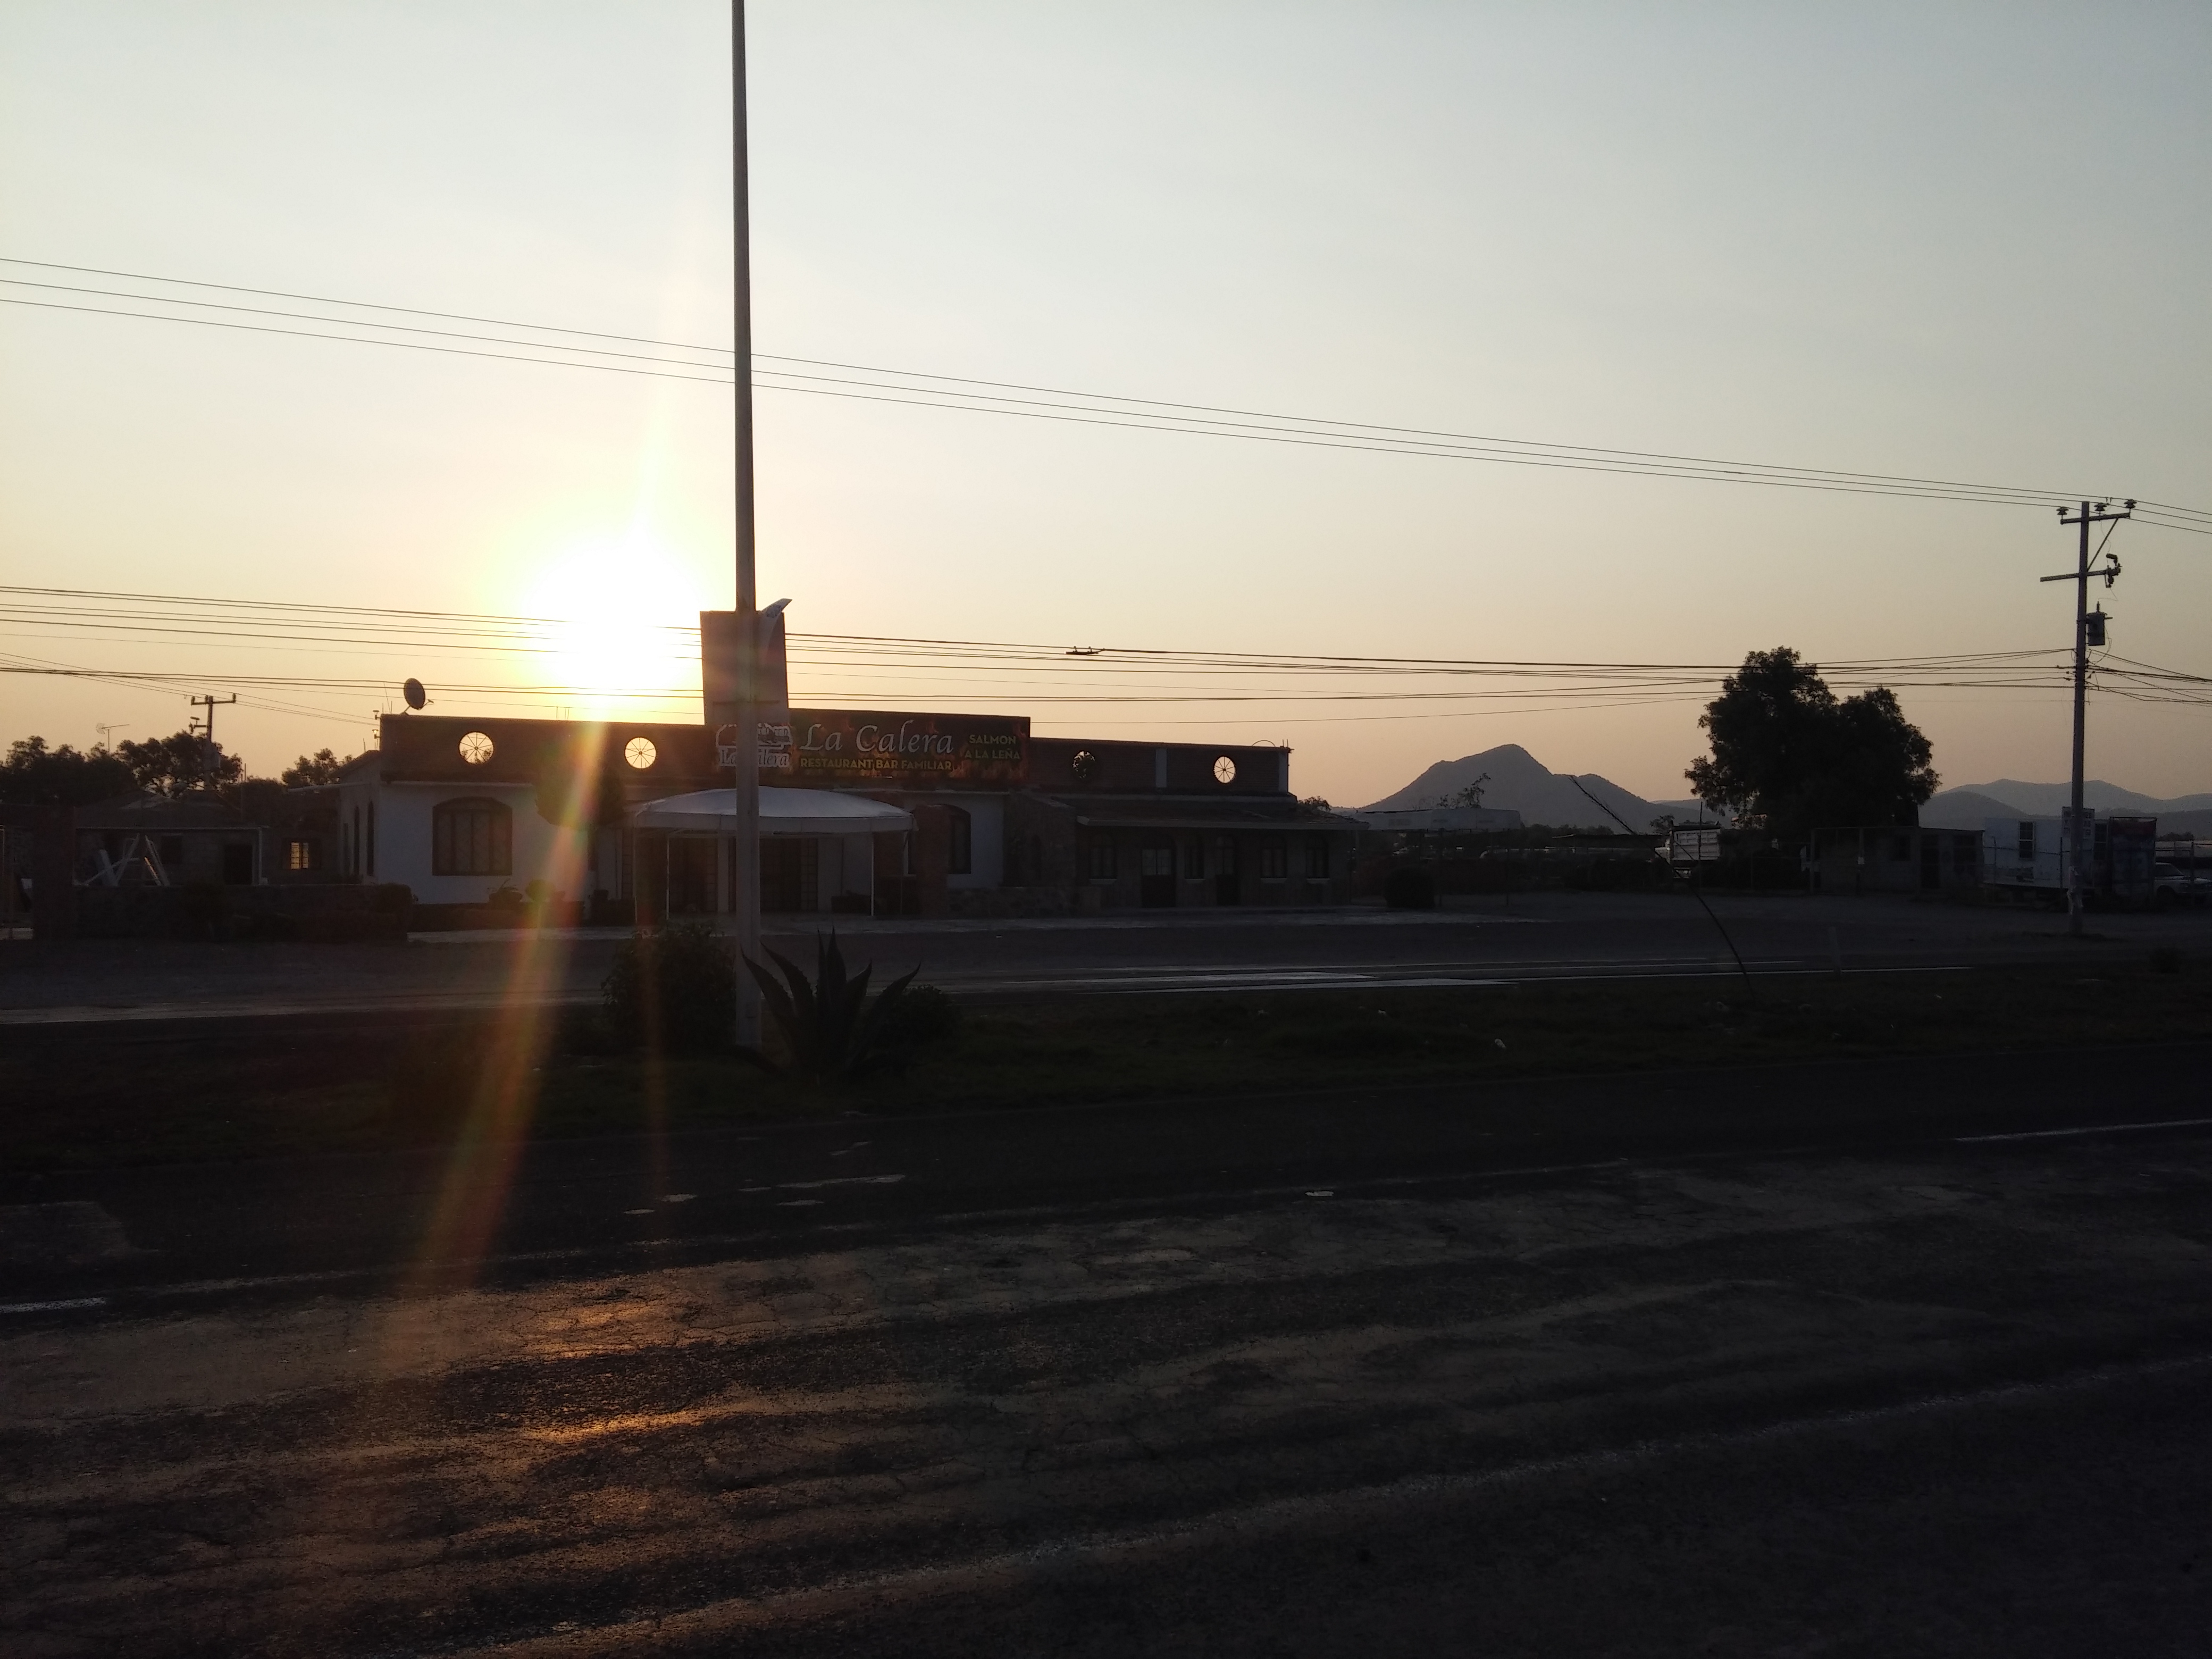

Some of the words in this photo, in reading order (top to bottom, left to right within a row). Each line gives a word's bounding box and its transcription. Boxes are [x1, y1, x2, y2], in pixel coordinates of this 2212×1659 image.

[799, 724, 843, 751] La
[856, 719, 954, 754] Calera
[969, 734, 1016, 744] SALMON
[965, 750, 972, 758] A
[975, 750, 989, 758] LA
[992, 748, 1020, 759] LEÑA
[800, 758, 873, 769] RESTAURANT
[877, 759, 898, 769] BAR
[901, 760, 952, 770] FAMILIAR
